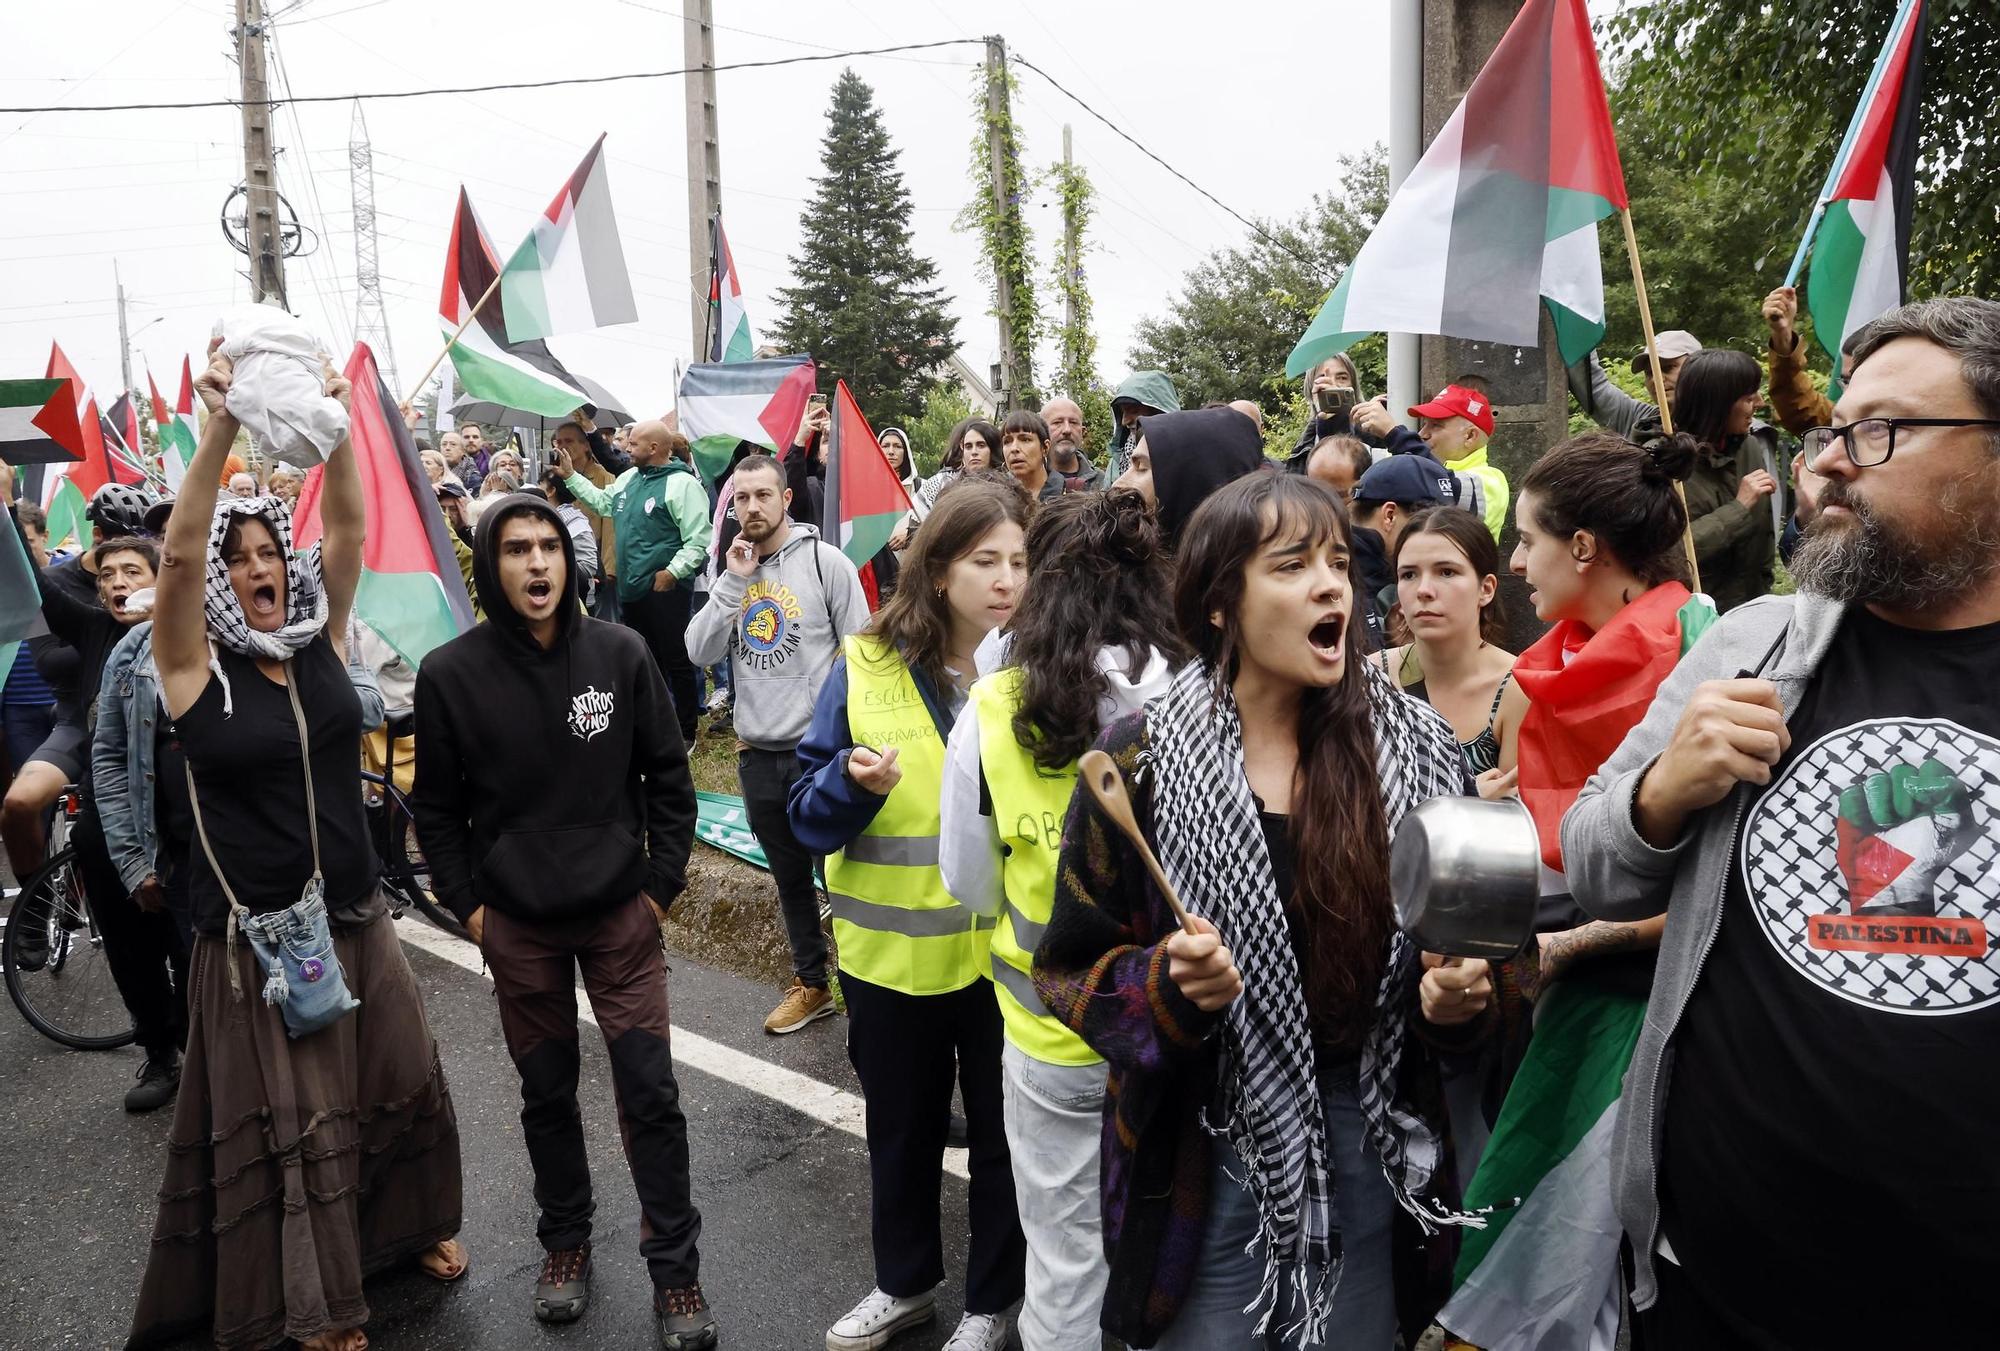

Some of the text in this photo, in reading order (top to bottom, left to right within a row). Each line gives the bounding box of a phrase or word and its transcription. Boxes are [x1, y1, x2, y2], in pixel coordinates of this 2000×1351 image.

[747, 580, 803, 619] BULLDOG
[733, 632, 801, 670] AMSTERDAM
[865, 687, 921, 706] ESCULC
[1818, 923, 1974, 945] PALESTINA
